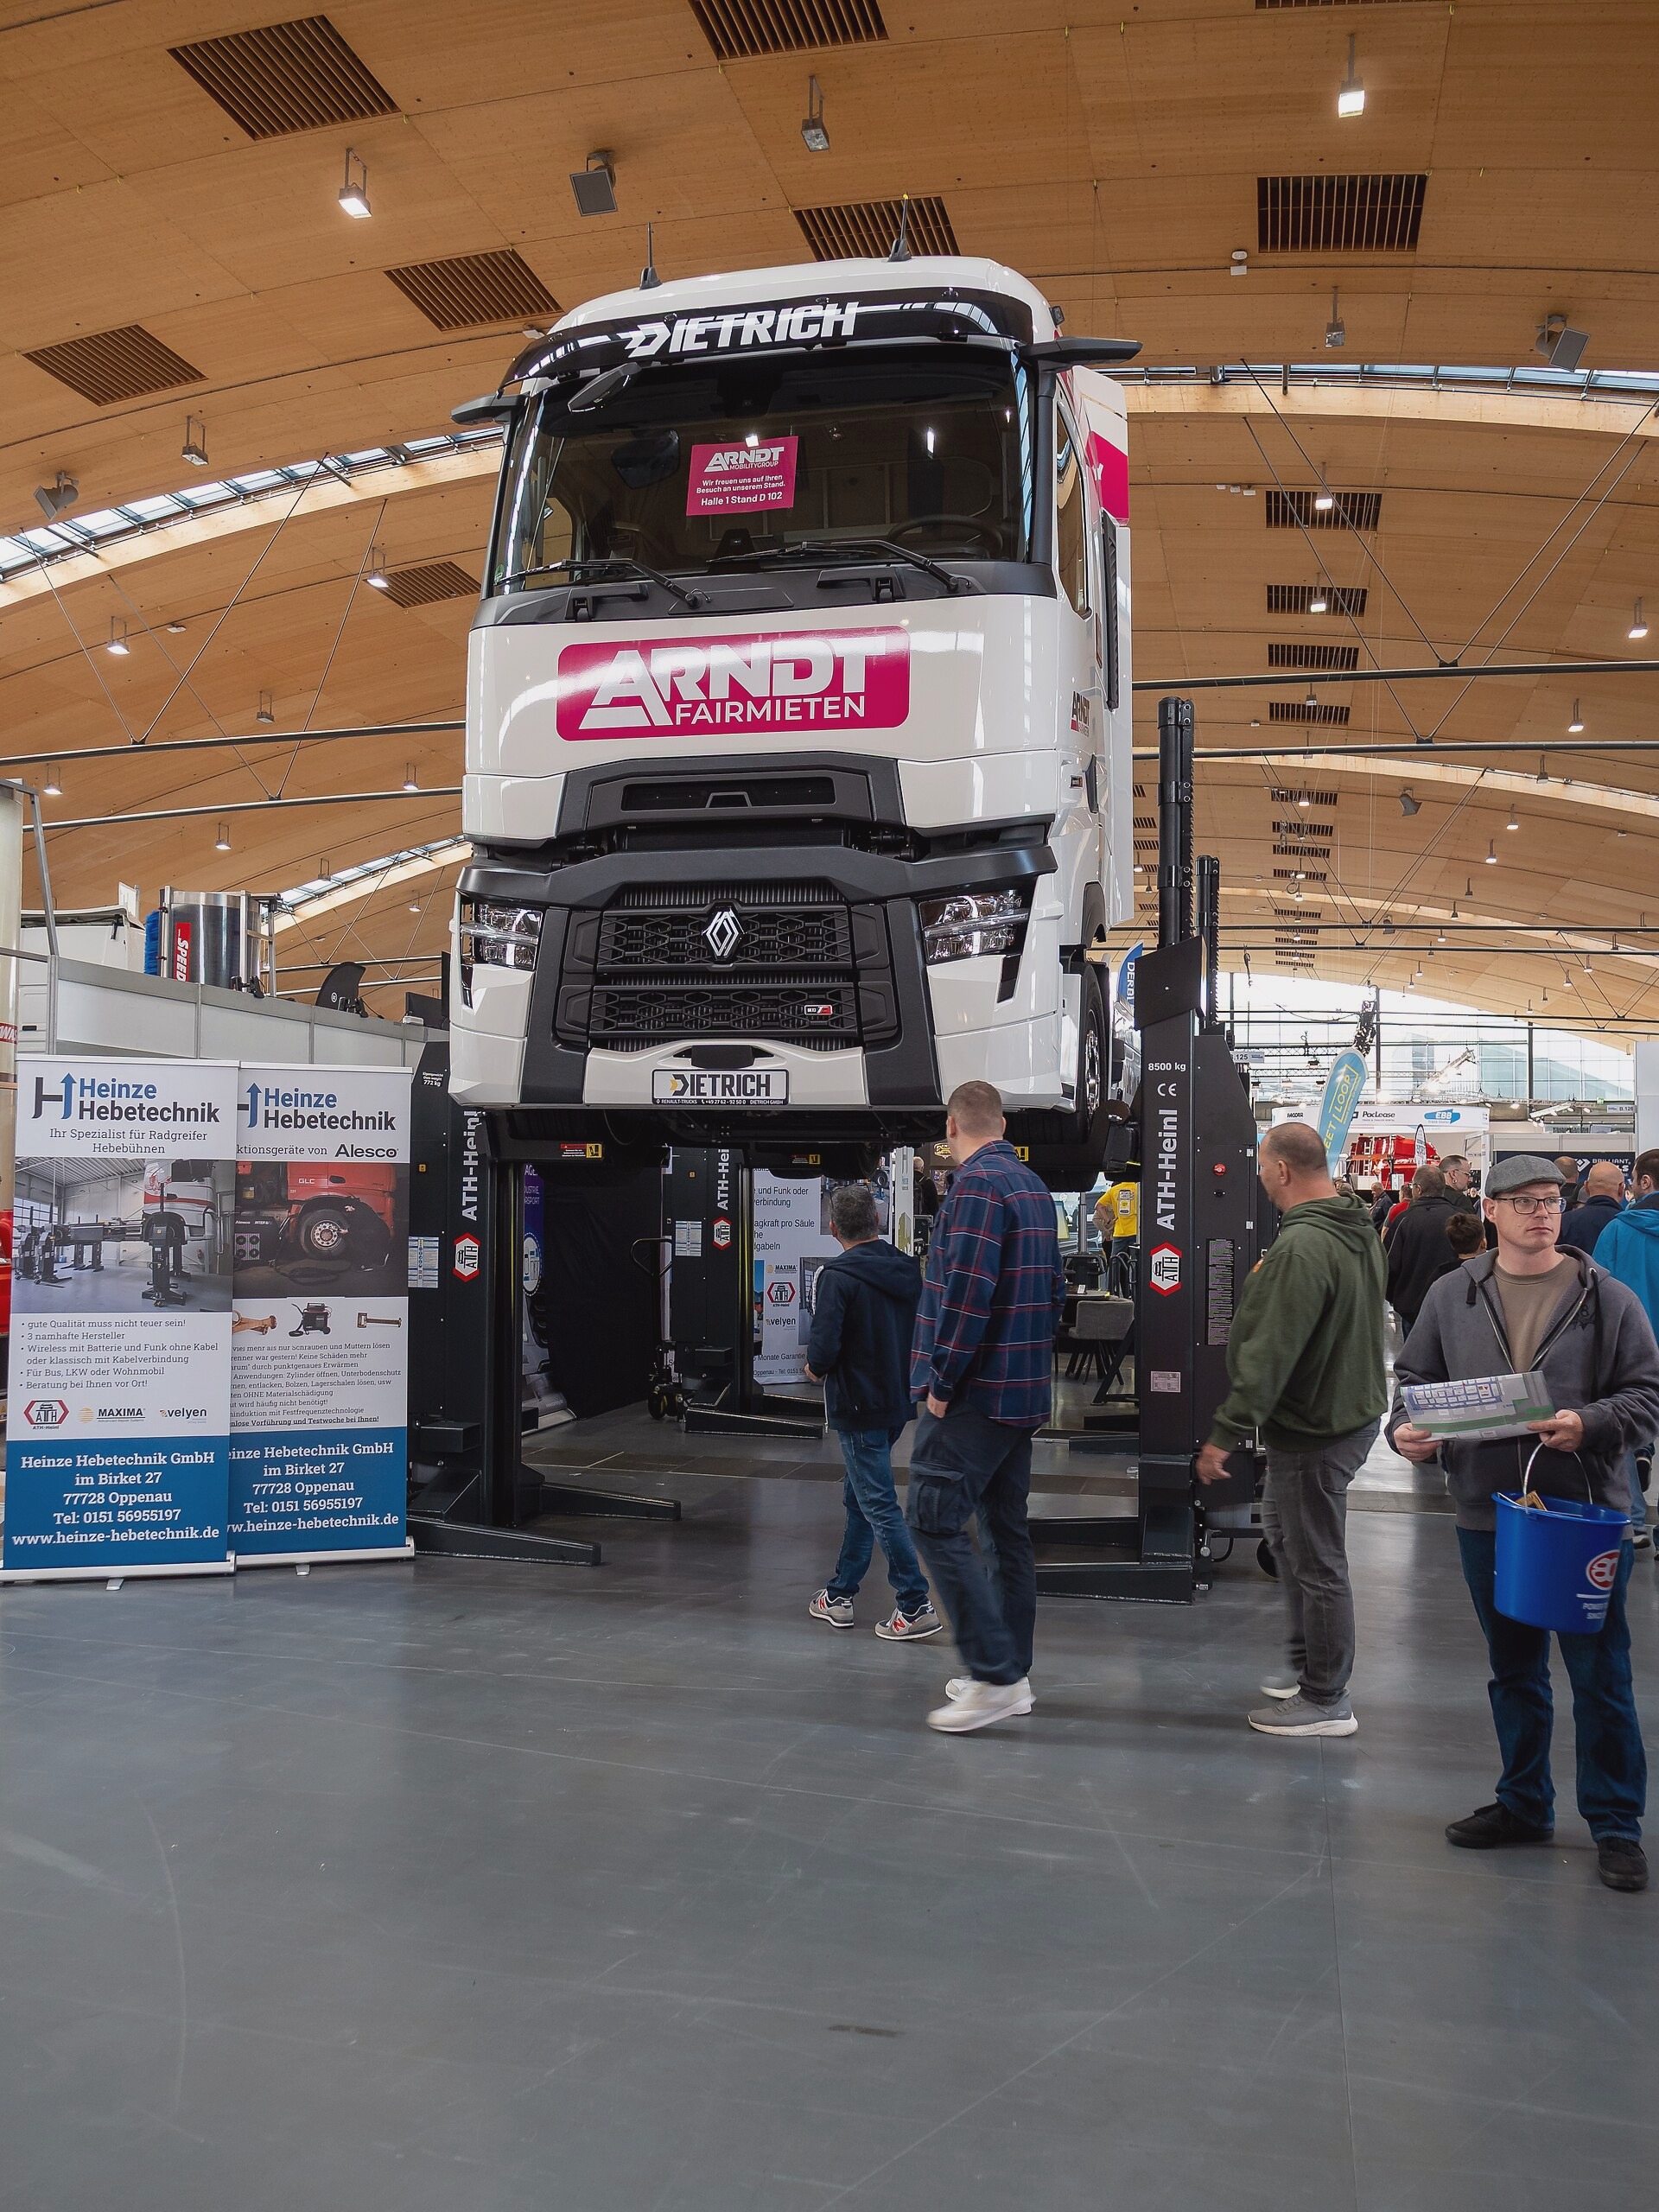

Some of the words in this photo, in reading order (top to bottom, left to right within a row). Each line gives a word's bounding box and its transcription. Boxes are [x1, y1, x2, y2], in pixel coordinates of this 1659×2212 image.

[624, 302, 860, 358] DIETRICH
[704, 446, 785, 473] ARNDT
[729, 461, 779, 471] MOBILITYGROUP
[763, 480, 785, 489] Stand.
[701, 497, 724, 506] Halle
[726, 496, 729, 505] 1
[730, 494, 759, 504] Stand
[760, 493, 766, 502] D
[767, 491, 783, 500] 102
[578, 637, 886, 730] ARNDT
[675, 696, 865, 725] FAIRMIETEN
[176, 937, 189, 982] SPEED
[1148, 1062, 1172, 1071] 8500
[1174, 1062, 1186, 1072] kg
[79, 1077, 157, 1099] Heinze
[671, 1074, 771, 1096] DIETRICH
[264, 1087, 337, 1108] Heinze
[1334, 1074, 1351, 1112] LOOP
[79, 1100, 220, 1122] Hebetechnik
[264, 1109, 397, 1131] Hebetechnik
[49, 1128, 67, 1138] Ihr
[70, 1128, 126, 1141] Spezialist
[130, 1128, 145, 1140] für
[149, 1129, 207, 1142] Radgreifer
[92, 1143, 165, 1154] Hebebühnen
[307, 1147, 327, 1155] von
[334, 1143, 397, 1158] Alesco
[461, 1111, 480, 1221] ATH-Heinl
[1156, 1109, 1178, 1231] ATH-Heinl
[794, 1219, 815, 1228] Säule
[721, 1225, 730, 1241] ATH
[464, 1245, 478, 1268] ATH
[1162, 1256, 1178, 1281] ATH
[774, 1290, 788, 1301] ATH
[28, 1320, 48, 1330] gute
[49, 1319, 86, 1328] Qualität
[771, 1317, 796, 1326] velyen
[35, 1332, 79, 1340] namhafte
[69, 1344, 85, 1352] mit
[87, 1344, 122, 1352] Batterie
[169, 1343, 191, 1351] ohne
[49, 1356, 92, 1364] klassisch
[112, 1355, 189, 1364] Kabelverbindung
[758, 1353, 779, 1362] Monate
[26, 1369, 42, 1377] Für
[44, 1369, 64, 1377] Bus,
[66, 1368, 87, 1376] LKW
[90, 1367, 111, 1376] oder
[112, 1367, 165, 1376] Wohnmobil
[273, 1363, 321, 1371] punktgenaues
[26, 1382, 67, 1390] Beratung
[70, 1380, 84, 1389] bei
[131, 1379, 148, 1388] Ort!
[265, 1389, 334, 1398] Materialschädigung
[35, 1409, 57, 1422] ATH
[98, 1408, 143, 1417] MAXIMA
[168, 1408, 207, 1419] velyen
[282, 1407, 365, 1416] Festfrequenztechnologie
[308, 1416, 345, 1425] Testwoche
[264, 1444, 349, 1459] Hebetechnik
[353, 1442, 394, 1455] GmbH
[21, 1455, 73, 1468] Heinze
[75, 1452, 167, 1467] Hebetechnik
[170, 1452, 215, 1465] GmbH
[263, 1465, 282, 1477] im
[284, 1463, 326, 1476] Birket
[328, 1462, 345, 1474] 27
[75, 1473, 95, 1486] im
[98, 1472, 142, 1485] Birket
[145, 1471, 162, 1484] 27
[252, 1483, 292, 1495] 77728
[295, 1481, 354, 1496] Oppenau
[62, 1493, 105, 1505] 77728
[108, 1492, 172, 1506] Oppenau
[244, 1502, 269, 1514] Tel:
[271, 1500, 300, 1513] 0151
[303, 1497, 363, 1511] 56955197
[53, 1512, 80, 1524] Tel:
[83, 1511, 113, 1523] 0151
[117, 1509, 181, 1522] 56955197
[11, 1526, 219, 1546] www.heinze-hebetechnik.de
[893, 1618, 906, 1632] N
